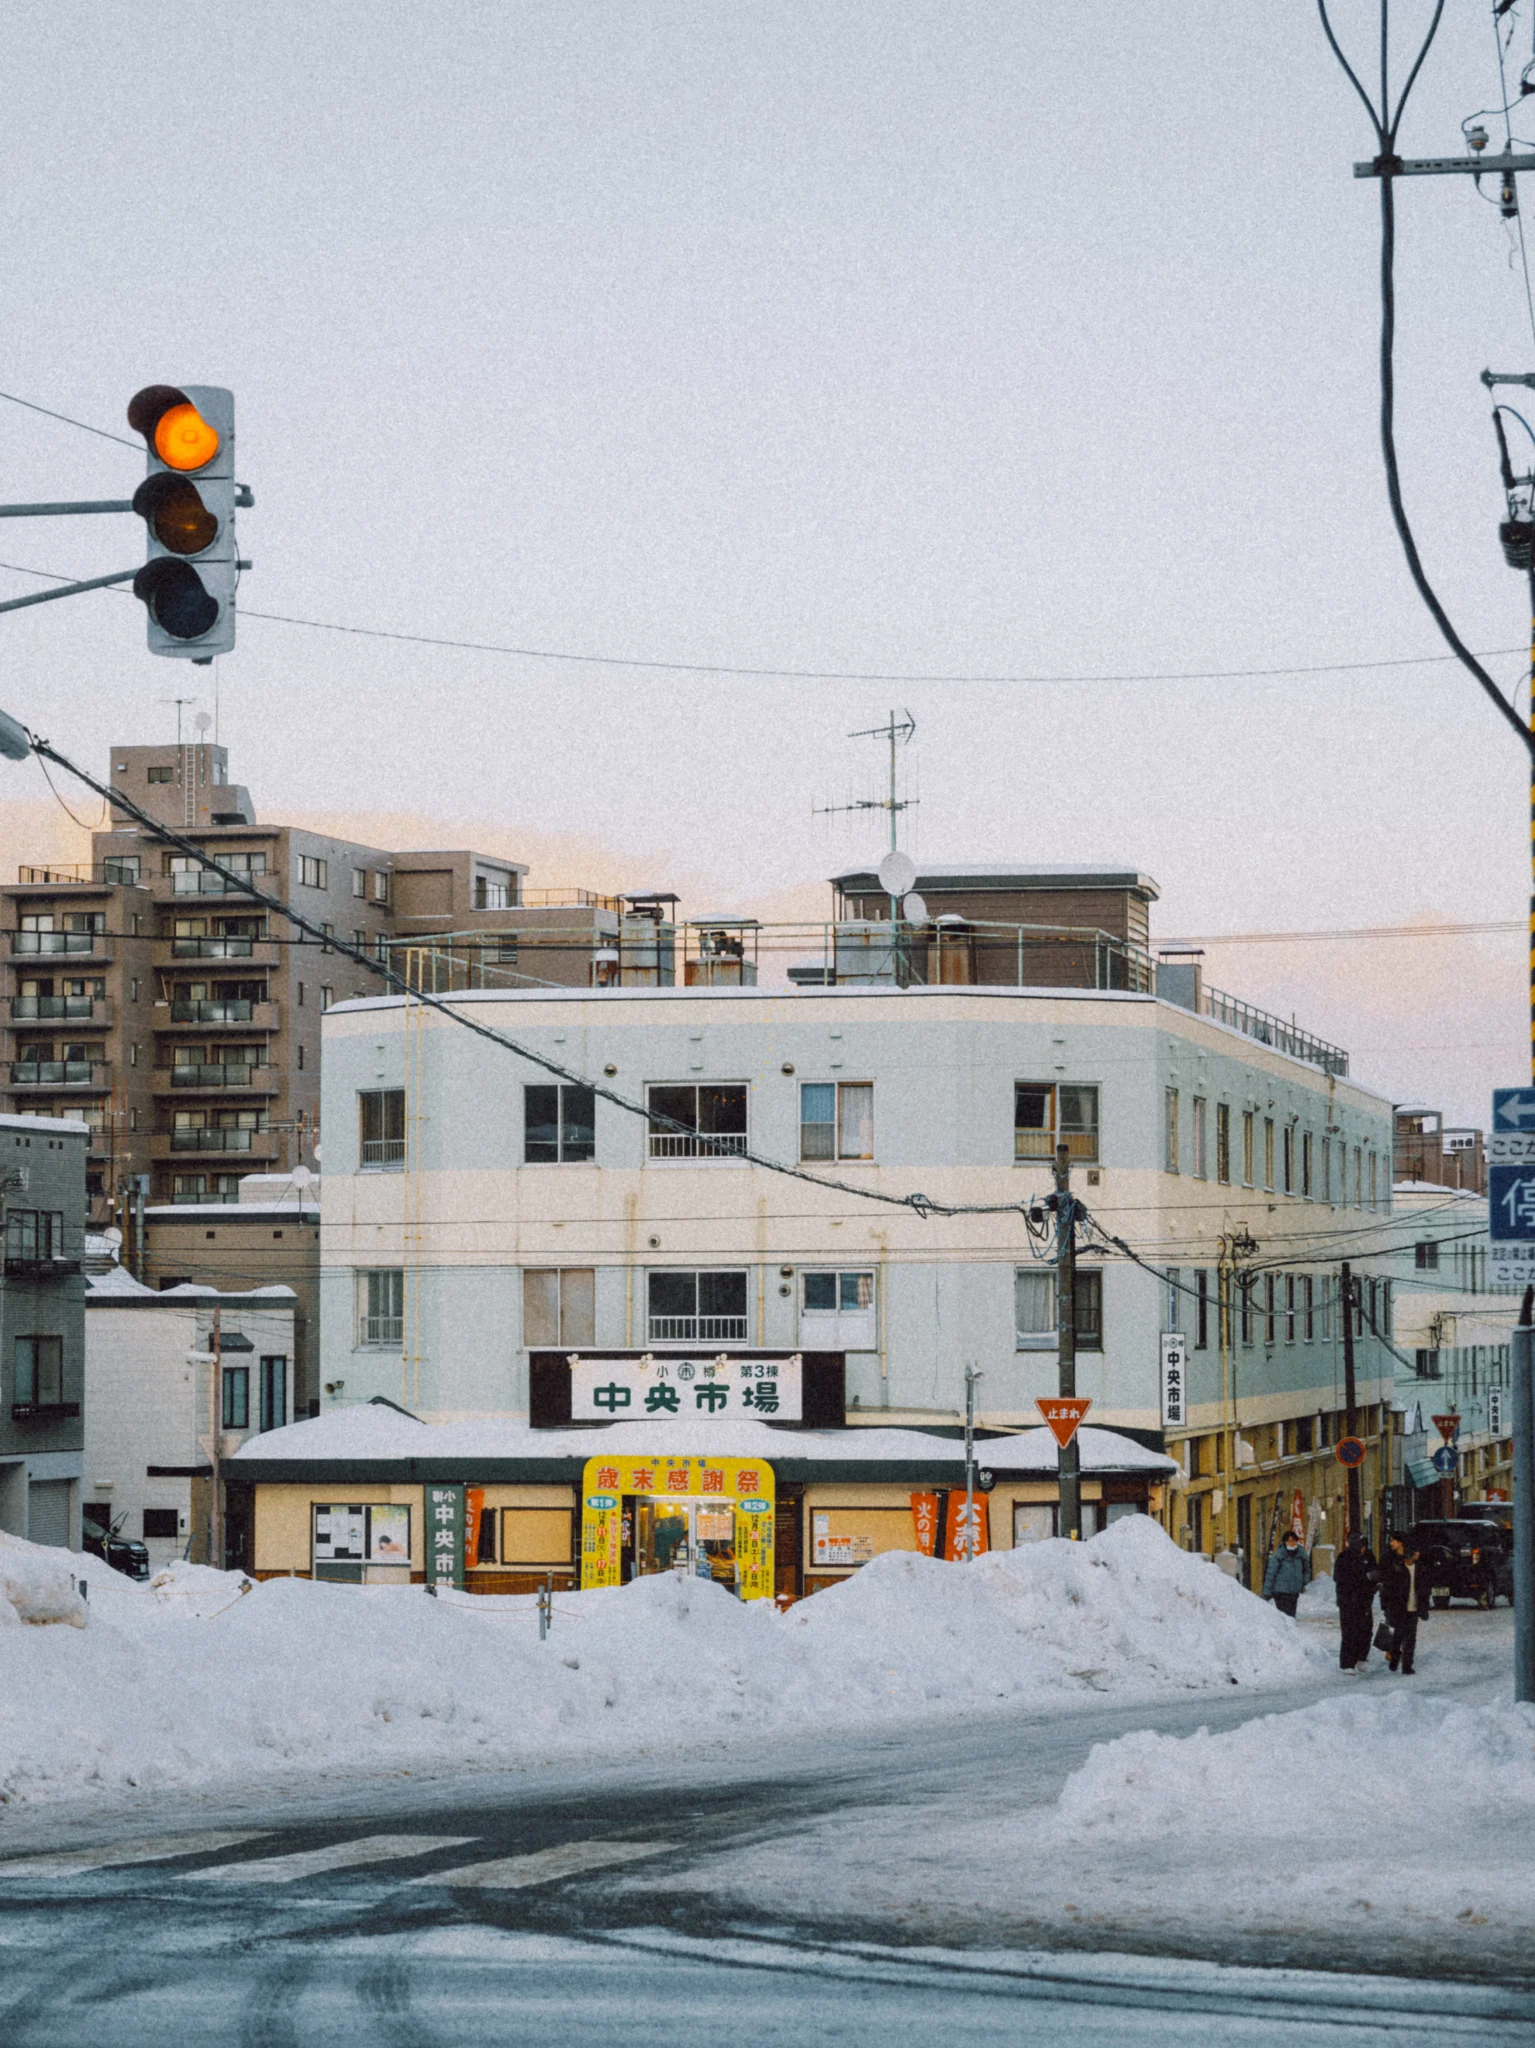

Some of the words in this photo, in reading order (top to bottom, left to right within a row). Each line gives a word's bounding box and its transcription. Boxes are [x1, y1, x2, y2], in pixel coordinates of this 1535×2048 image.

[740, 1365, 779, 1378] 第3棟
[593, 1381, 780, 1413] 中央市場
[1167, 1351, 1180, 1421] 中央市場
[1047, 1408, 1081, 1419] 止まれ
[651, 1459, 706, 1467] 中央市場
[596, 1468, 760, 1493] 歳末感謝祭
[917, 1502, 932, 1554] 火の用
